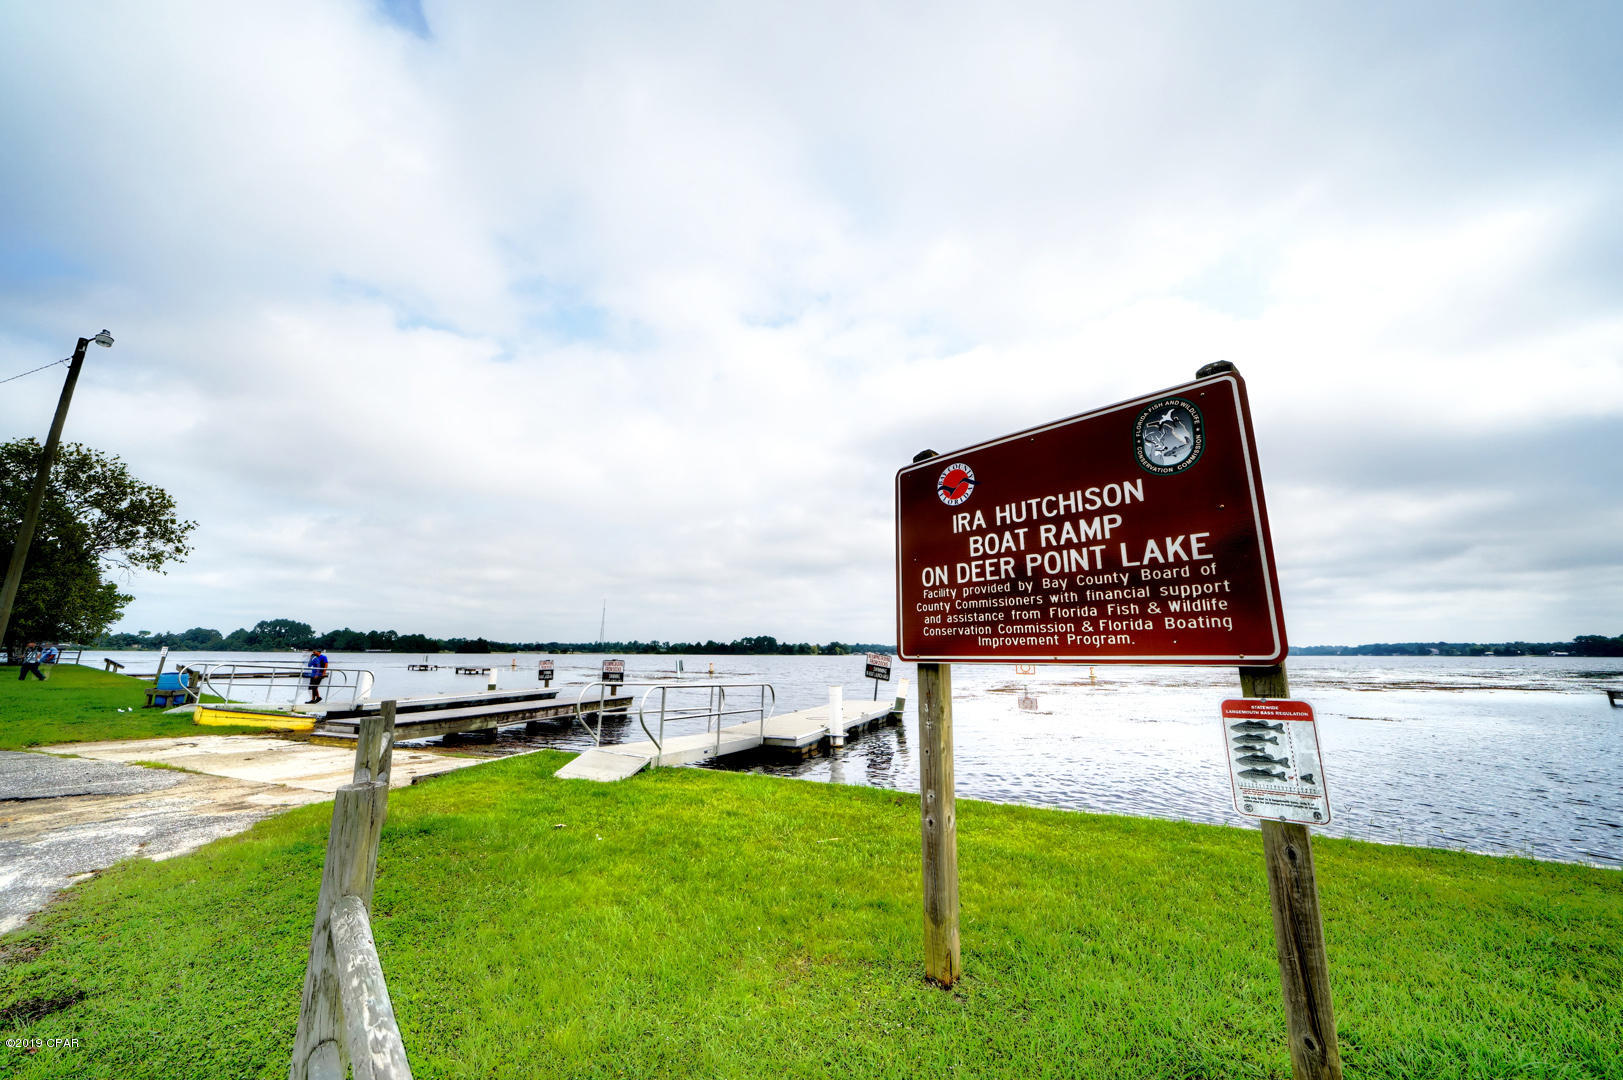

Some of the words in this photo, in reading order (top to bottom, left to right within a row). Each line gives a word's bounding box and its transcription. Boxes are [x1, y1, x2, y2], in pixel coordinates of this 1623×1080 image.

[1136, 412, 1148, 437] FLORIDA
[1148, 403, 1163, 412] FISH
[1180, 402, 1200, 424] WILDLIFE
[1137, 446, 1173, 473] CONSERVATION
[1178, 435, 1201, 470] COMMISSION
[952, 509, 987, 534] IRA
[995, 478, 1145, 526] HUTCHISON
[969, 527, 1029, 558] BOAT
[1040, 514, 1122, 548] RAMP
[922, 564, 949, 587] ON
[956, 557, 1016, 584] DEER
[1025, 545, 1106, 577] POINT
[1120, 532, 1214, 567] LAKE
[916, 602, 951, 613] County
[955, 595, 1043, 610] Commissioners
[1050, 592, 1078, 604] with
[1086, 586, 1150, 601] financial
[1160, 580, 1231, 598] support
[924, 588, 956, 600] Facility
[963, 582, 1010, 598] provided
[1018, 581, 1033, 593] by
[1042, 578, 1068, 590] Bay
[1076, 572, 1129, 586] County
[1141, 565, 1190, 581] Board
[1200, 562, 1217, 576] of
[923, 625, 992, 636] Conservation
[998, 622, 1075, 634] Commission
[1082, 621, 1094, 632] &
[1099, 619, 1153, 631] Florida
[1165, 616, 1232, 631] Boating
[924, 614, 941, 624] and
[947, 611, 1005, 623] assistance
[1011, 609, 1041, 620] from
[1050, 606, 1098, 618] Florida
[1107, 603, 1139, 615] Fish
[1147, 601, 1162, 614] &
[1168, 599, 1228, 613] Wildlife
[978, 634, 1059, 648] Improvement
[1067, 634, 1136, 648] Program.
